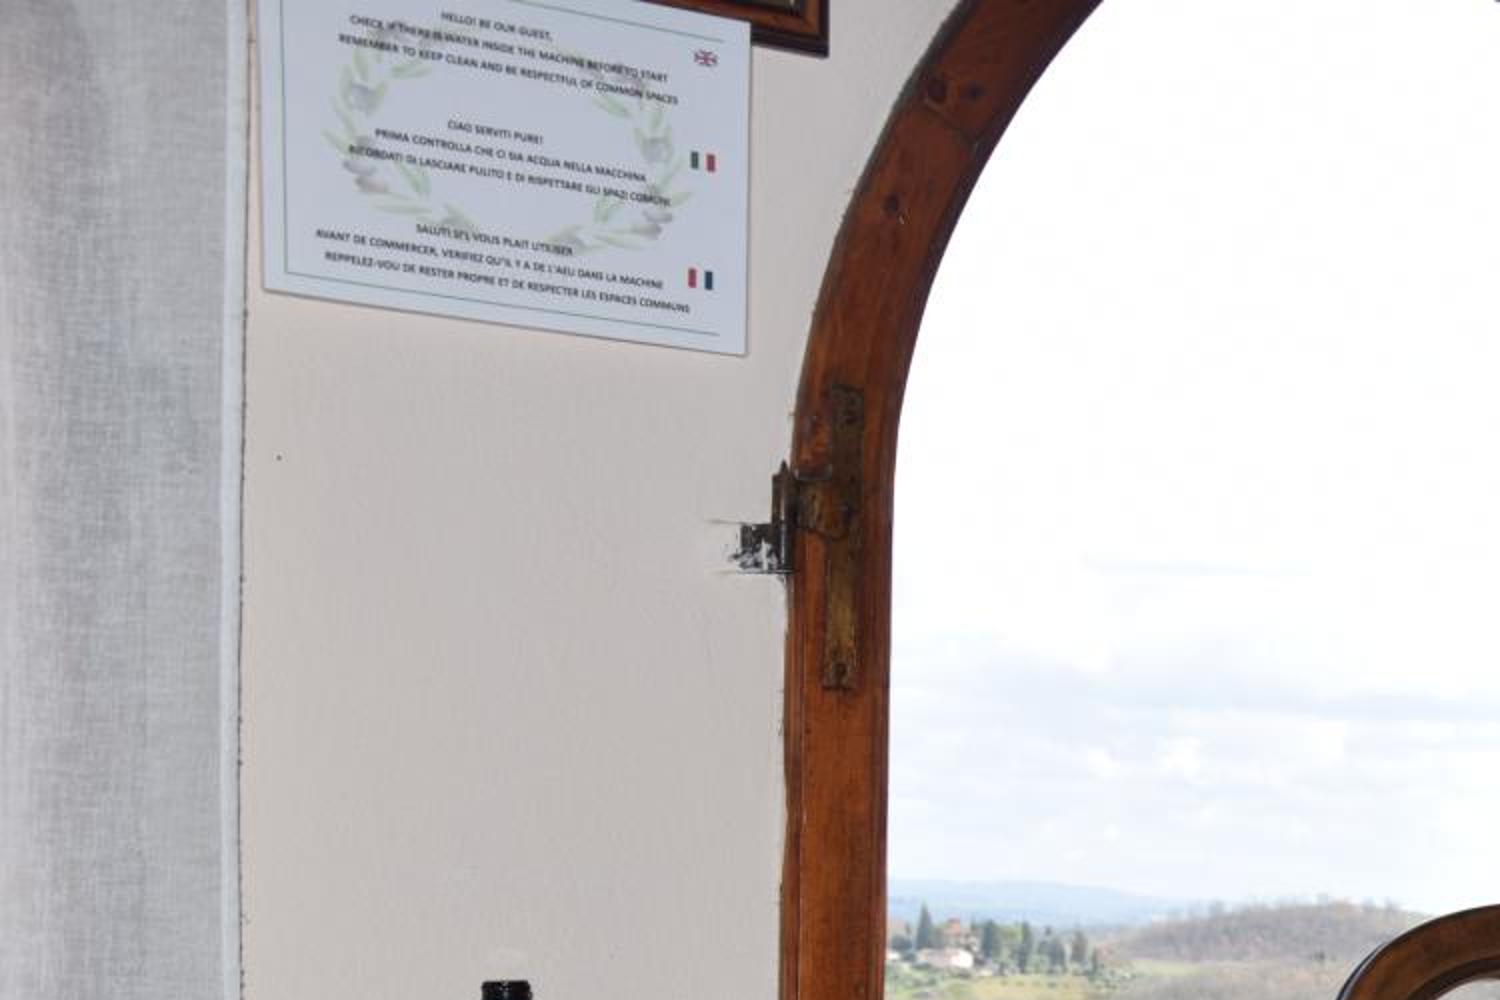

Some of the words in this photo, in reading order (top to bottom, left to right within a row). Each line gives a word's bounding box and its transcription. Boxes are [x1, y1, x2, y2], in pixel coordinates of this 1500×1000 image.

[350, 15, 384, 31] CHECK
[387, 21, 396, 31] IF
[396, 22, 430, 39] THERE
[432, 31, 443, 41] IS
[445, 32, 479, 48] WATER
[482, 41, 514, 54] INSIDE
[518, 47, 535, 58] THE
[539, 51, 585, 68] MACHINE
[587, 60, 621, 75] BEFORE
[622, 66, 638, 78] TO
[640, 69, 668, 83] START
[441, 12, 476, 25] HELLO!
[479, 19, 490, 28] BE
[494, 21, 516, 33] OUR
[518, 26, 553, 41] GUEST,
[339, 33, 399, 53] REMEMBER
[403, 46, 416, 57] TO
[419, 49, 443, 61] KEEP
[446, 53, 478, 68] CLEAN
[480, 60, 503, 73] AND
[506, 65, 517, 75] BE
[520, 68, 578, 87] RESPECTFUL
[580, 79, 593, 89] OF
[595, 81, 643, 98] COMMON
[646, 90, 678, 106] SPACES
[375, 128, 410, 142] PRIMA
[412, 135, 472, 153] CONTROLLA
[474, 145, 494, 156] CHE
[496, 149, 507, 159] CI
[508, 152, 524, 162] SIA
[527, 154, 560, 168] ACQUA
[563, 161, 593, 174] NELLA
[595, 165, 647, 182] MACCHINA
[447, 119, 473, 133] CIAO
[475, 124, 511, 139] SERVITI
[514, 132, 543, 145] PURE!
[348, 144, 403, 162] RICORDATI
[406, 154, 417, 164] DI
[419, 157, 466, 173] LASCIARE
[468, 165, 505, 179] PULITO
[506, 171, 513, 181] E
[515, 172, 525, 182] DI
[527, 175, 583, 193] RISPETTARE
[585, 185, 601, 195] GLI
[603, 187, 628, 201] SPAZI
[316, 228, 350, 242] AVANT
[353, 235, 366, 245] DE
[441, 248, 484, 264] VERIFIEZ
[485, 255, 513, 269] QU'IL
[515, 259, 522, 268] Y
[523, 260, 531, 270] A
[533, 262, 545, 273] DE
[578, 268, 603, 281] DANS
[606, 273, 617, 283] LA
[619, 274, 663, 289] MACHINE
[416, 223, 451, 237] SALUTI
[472, 232, 500, 245] VOUS
[503, 237, 529, 250] PLAIT
[531, 241, 573, 257] UTILISER
[402, 263, 416, 273] DE
[419, 265, 455, 279] RESTER
[457, 271, 495, 286] PROPRE
[498, 278, 511, 288] ET
[512, 279, 527, 289] DE
[528, 281, 579, 298] RESPECTER
[581, 290, 597, 300] LES
[600, 292, 637, 306] ESPACES
[640, 297, 691, 313] COMMUNS
